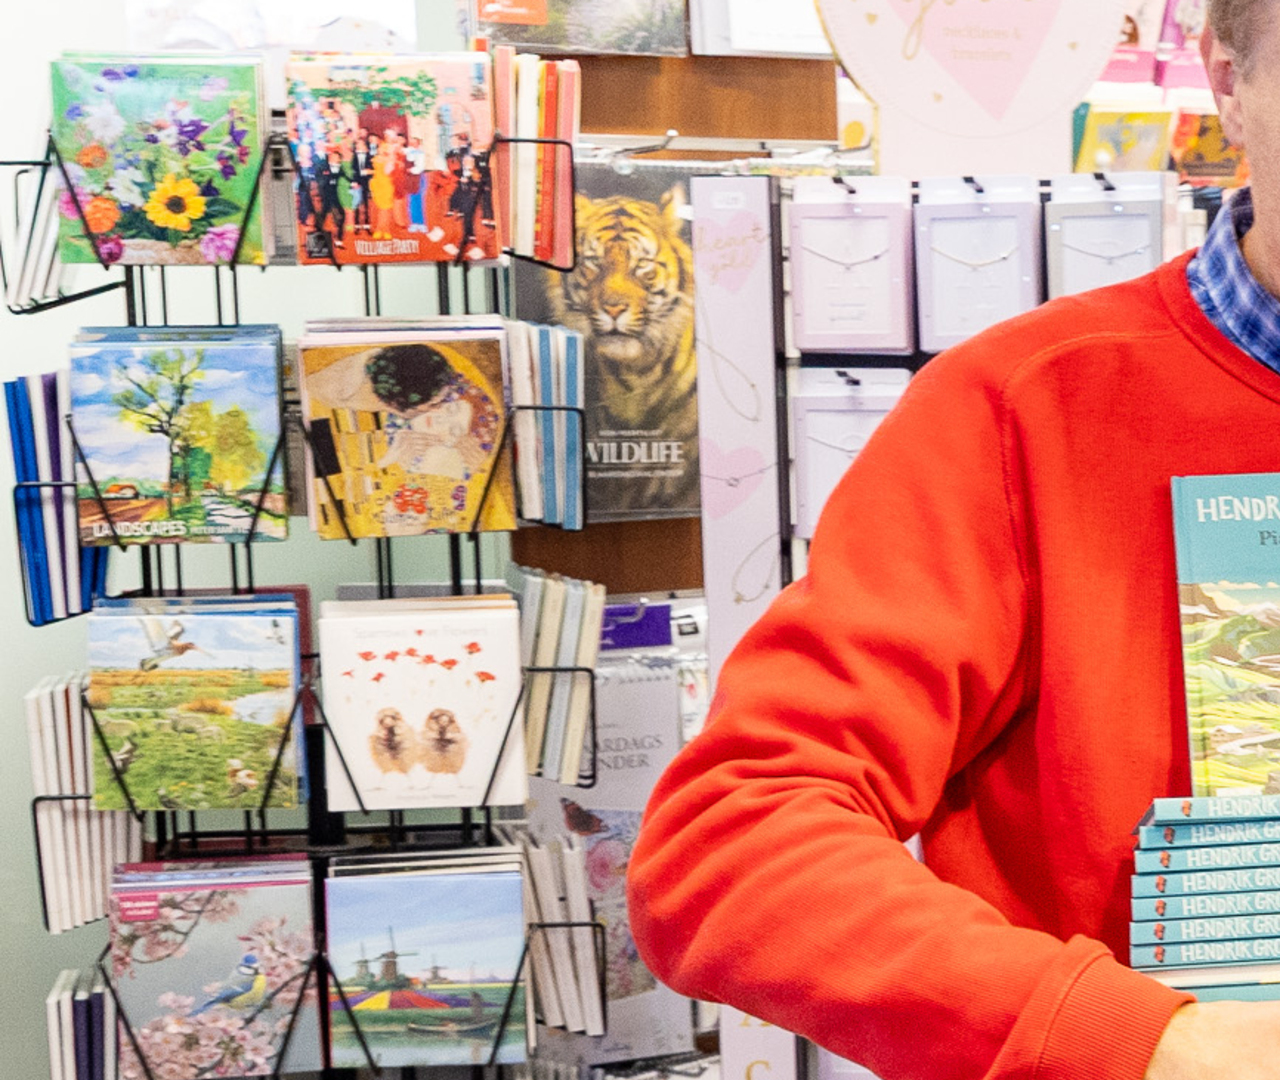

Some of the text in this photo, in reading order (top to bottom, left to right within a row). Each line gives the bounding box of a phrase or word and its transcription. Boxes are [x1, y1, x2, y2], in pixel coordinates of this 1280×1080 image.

[1208, 797, 1279, 817] HENDRIK
[1191, 822, 1262, 843] HENDRIK
[1187, 846, 1258, 867] HENDRIK
[1182, 871, 1254, 892] HENDRIK
[1182, 895, 1253, 916] HENDRIK
[1180, 918, 1251, 939] HENDRIK
[1180, 942, 1251, 962] HENDRIK
